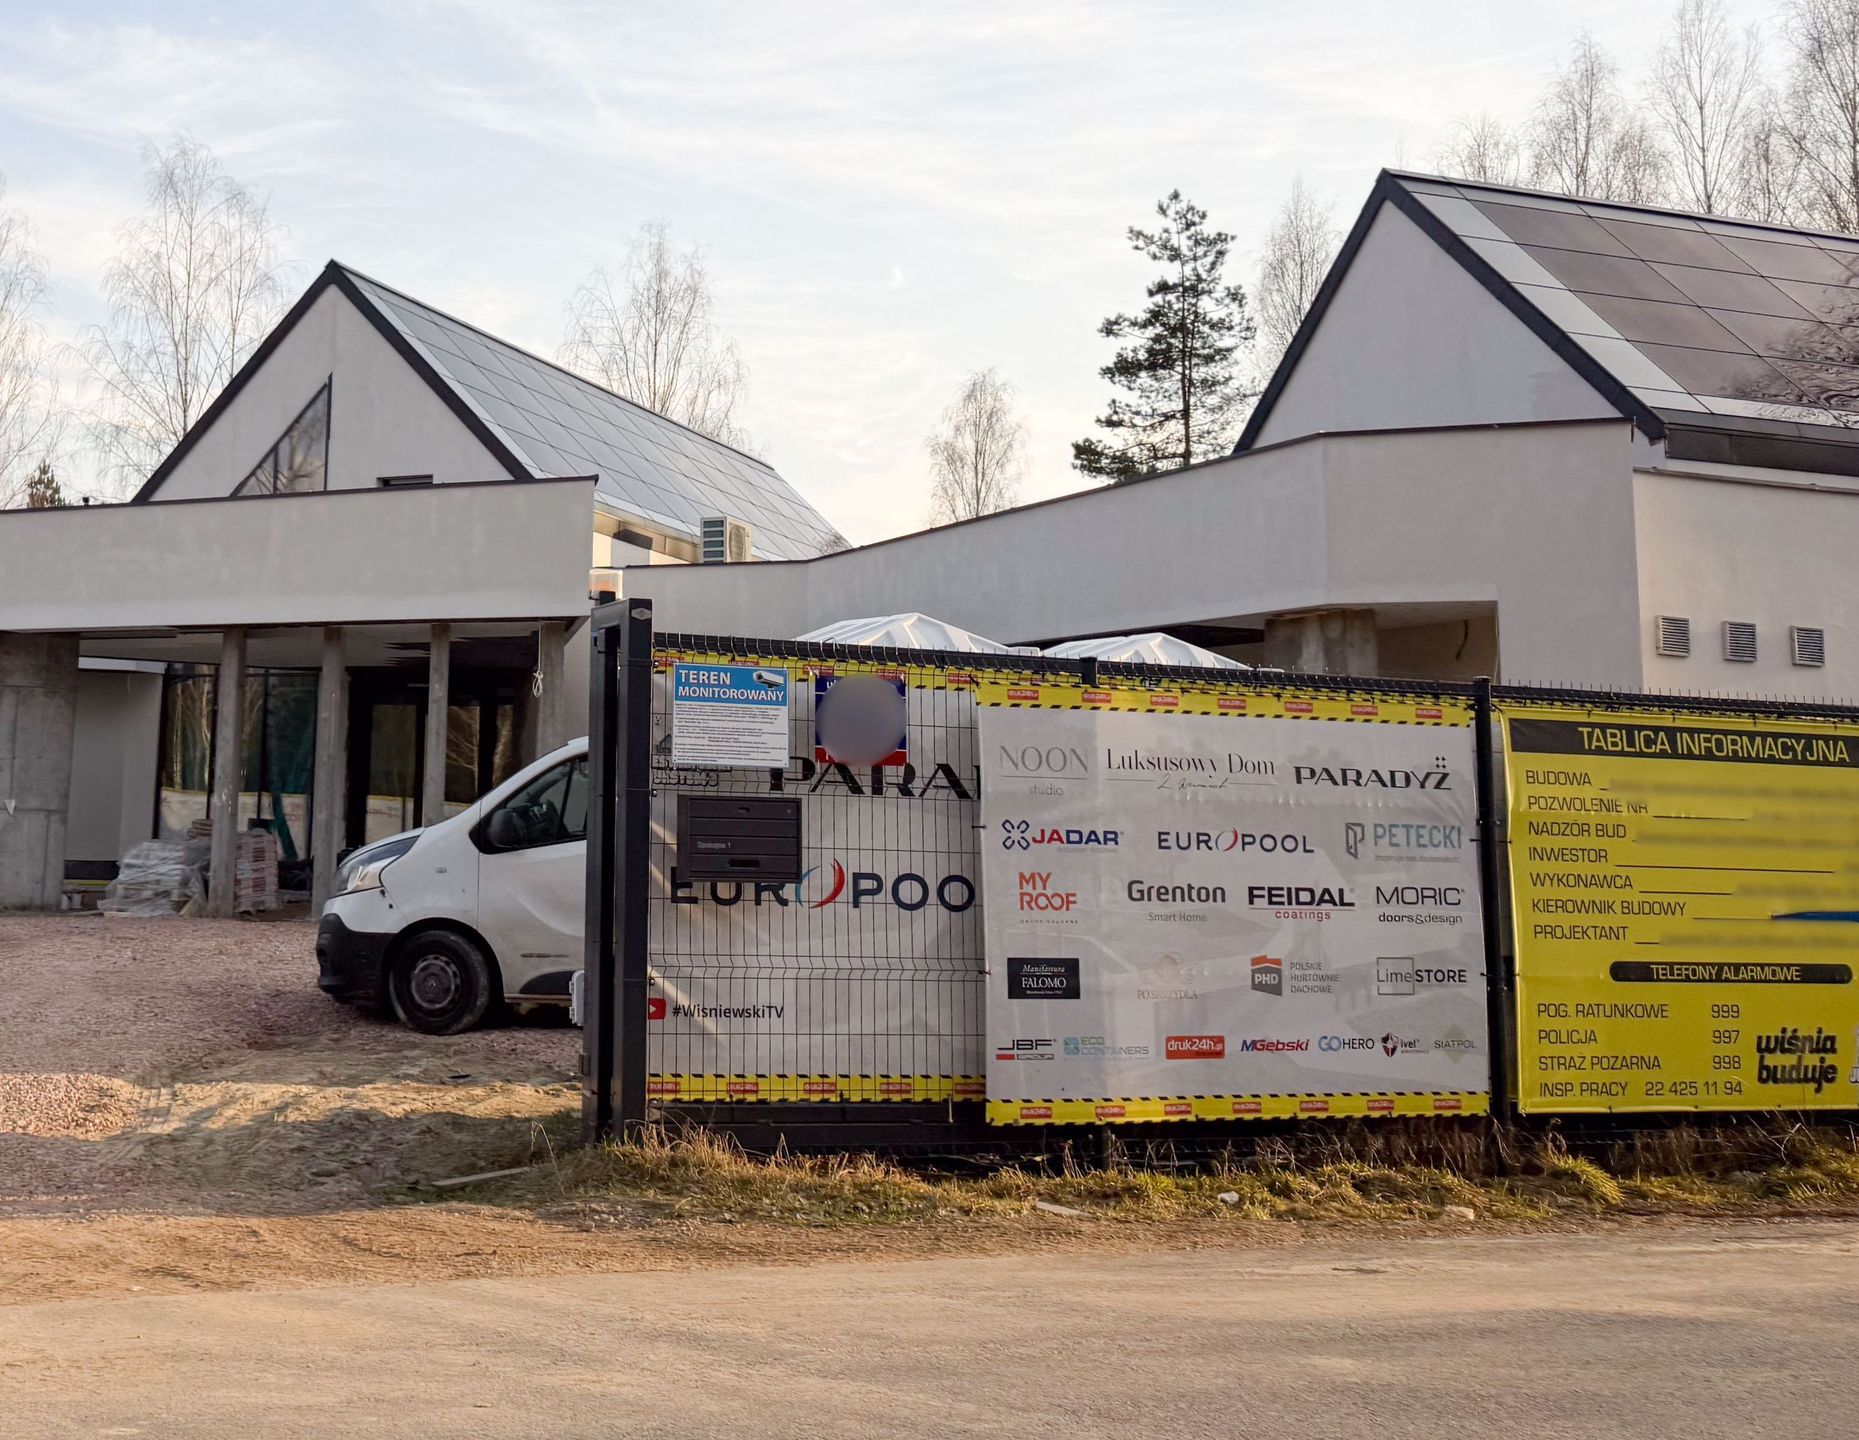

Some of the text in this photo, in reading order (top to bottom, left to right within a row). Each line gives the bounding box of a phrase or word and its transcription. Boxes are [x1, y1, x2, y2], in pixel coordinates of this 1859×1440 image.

[679, 670, 731, 685] TEREN
[678, 686, 785, 701] MONITOROWANY
[1578, 727, 1850, 762] TABLICA INFORMACYJNA
[1000, 745, 1088, 773] NOON
[1107, 748, 1275, 778] Luksusowy Dom
[770, 756, 982, 800] PARA
[1525, 770, 1592, 786] BUDOWA
[1028, 783, 1064, 796] studio
[1528, 795, 1623, 813] POZWOLENIE
[1032, 829, 1119, 845] JADAR
[1373, 823, 1462, 849] PETECKI
[1528, 820, 1627, 838] NADZÓR BUD
[1158, 827, 1315, 853] EUROPOOL
[1529, 847, 1608, 863] INWESTOR
[1018, 872, 1053, 890] MY
[1530, 872, 1633, 889] WYKONAWCA
[1127, 880, 1226, 903] Grenton
[1248, 886, 1355, 907] FEIDAL
[1376, 886, 1461, 905] MORIC
[1019, 893, 1077, 911] ROOF
[1532, 898, 1686, 916] KIEROWNIK BUDOWY
[1148, 912, 1207, 923] Smart Home
[1275, 911, 1331, 922] coatings
[1378, 912, 1462, 925] doors&design
[1534, 925, 1628, 940] PROJEKTANT
[1290, 962, 1322, 971] POLSKIE
[1650, 964, 1800, 980] TELEFONY ALARMOWE
[1022, 977, 1066, 989] FALOMO
[1254, 973, 1279, 985] PHD
[1290, 973, 1340, 982] HURTOWNIE
[1290, 985, 1333, 994] DACHOWE
[1537, 1003, 1740, 1019] POG. RATUNKOWE 999
[997, 1039, 1053, 1050] JBF
[1081, 1037, 1105, 1045] ECO
[1434, 1039, 1477, 1049] SIATPOL
[1538, 1029, 1740, 1044] POLICJA 997
[1756, 1027, 1838, 1054] wiśnia
[1081, 1046, 1149, 1056] CONTAINERS
[1712, 1055, 1741, 1069] 998
[1757, 1055, 1838, 1094] buduje
[1539, 1081, 1742, 1097] INSP. PRACY 22 425 11 94
